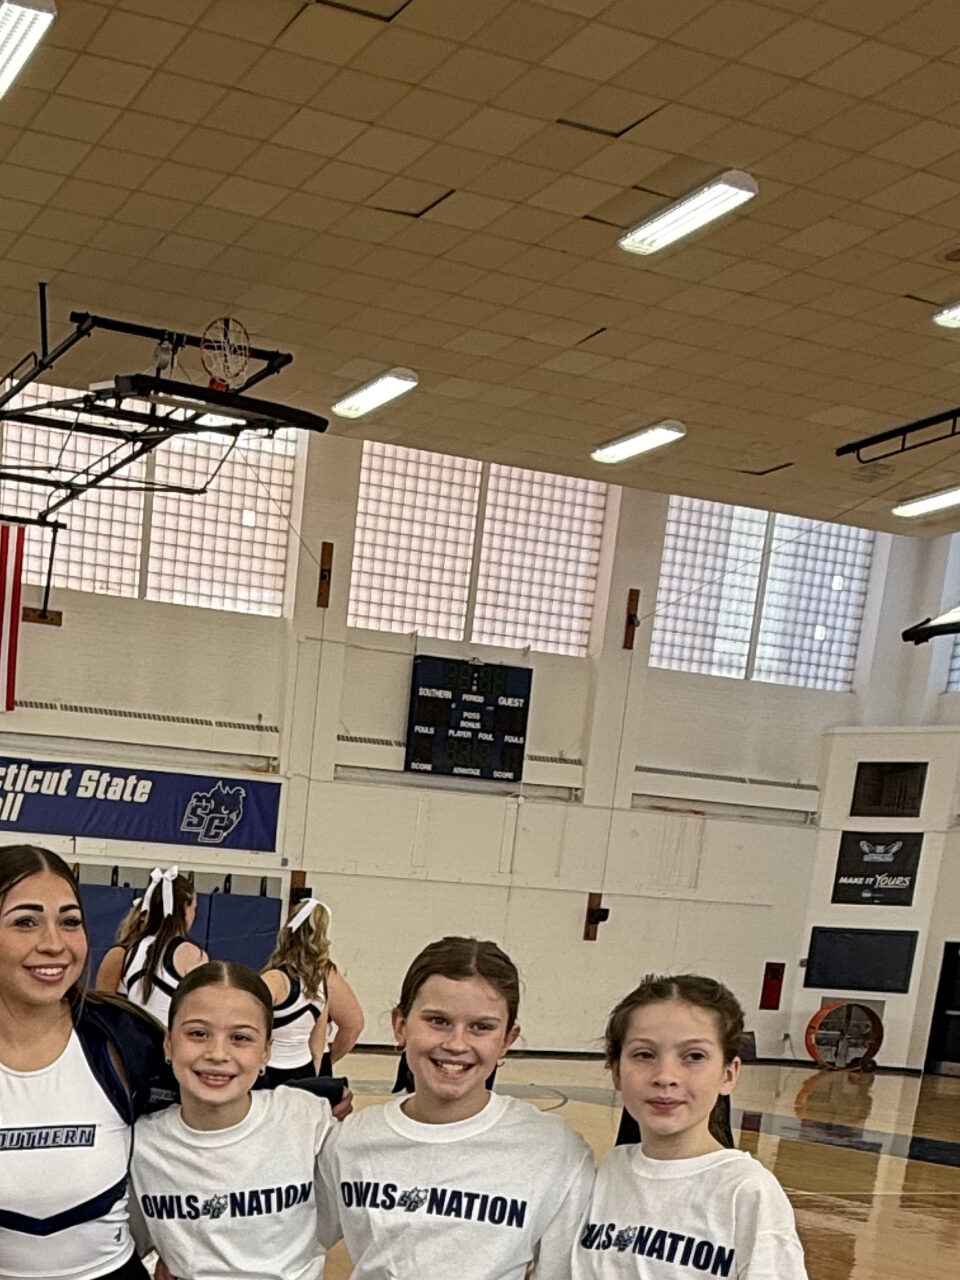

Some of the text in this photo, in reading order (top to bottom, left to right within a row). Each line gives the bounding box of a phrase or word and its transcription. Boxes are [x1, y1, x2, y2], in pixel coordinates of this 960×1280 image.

[462, 693, 485, 703] PERIOD
[498, 696, 525, 708] GUEST
[463, 711, 480, 720] POSS
[414, 725, 435, 735] FOULS
[448, 729, 495, 741] PLAYER FOUL
[504, 735, 524, 744] FOULS
[493, 770, 514, 779] SCORE
[76, 769, 153, 803] State
[838, 876, 864, 884] MAKE
[873, 873, 912, 888] YOURS
[140, 1194, 201, 1221] OWLS
[229, 1181, 314, 1218] NATION
[341, 1181, 397, 1211] OWLS
[426, 1187, 527, 1229] NATION
[632, 1225, 735, 1278] NATION
